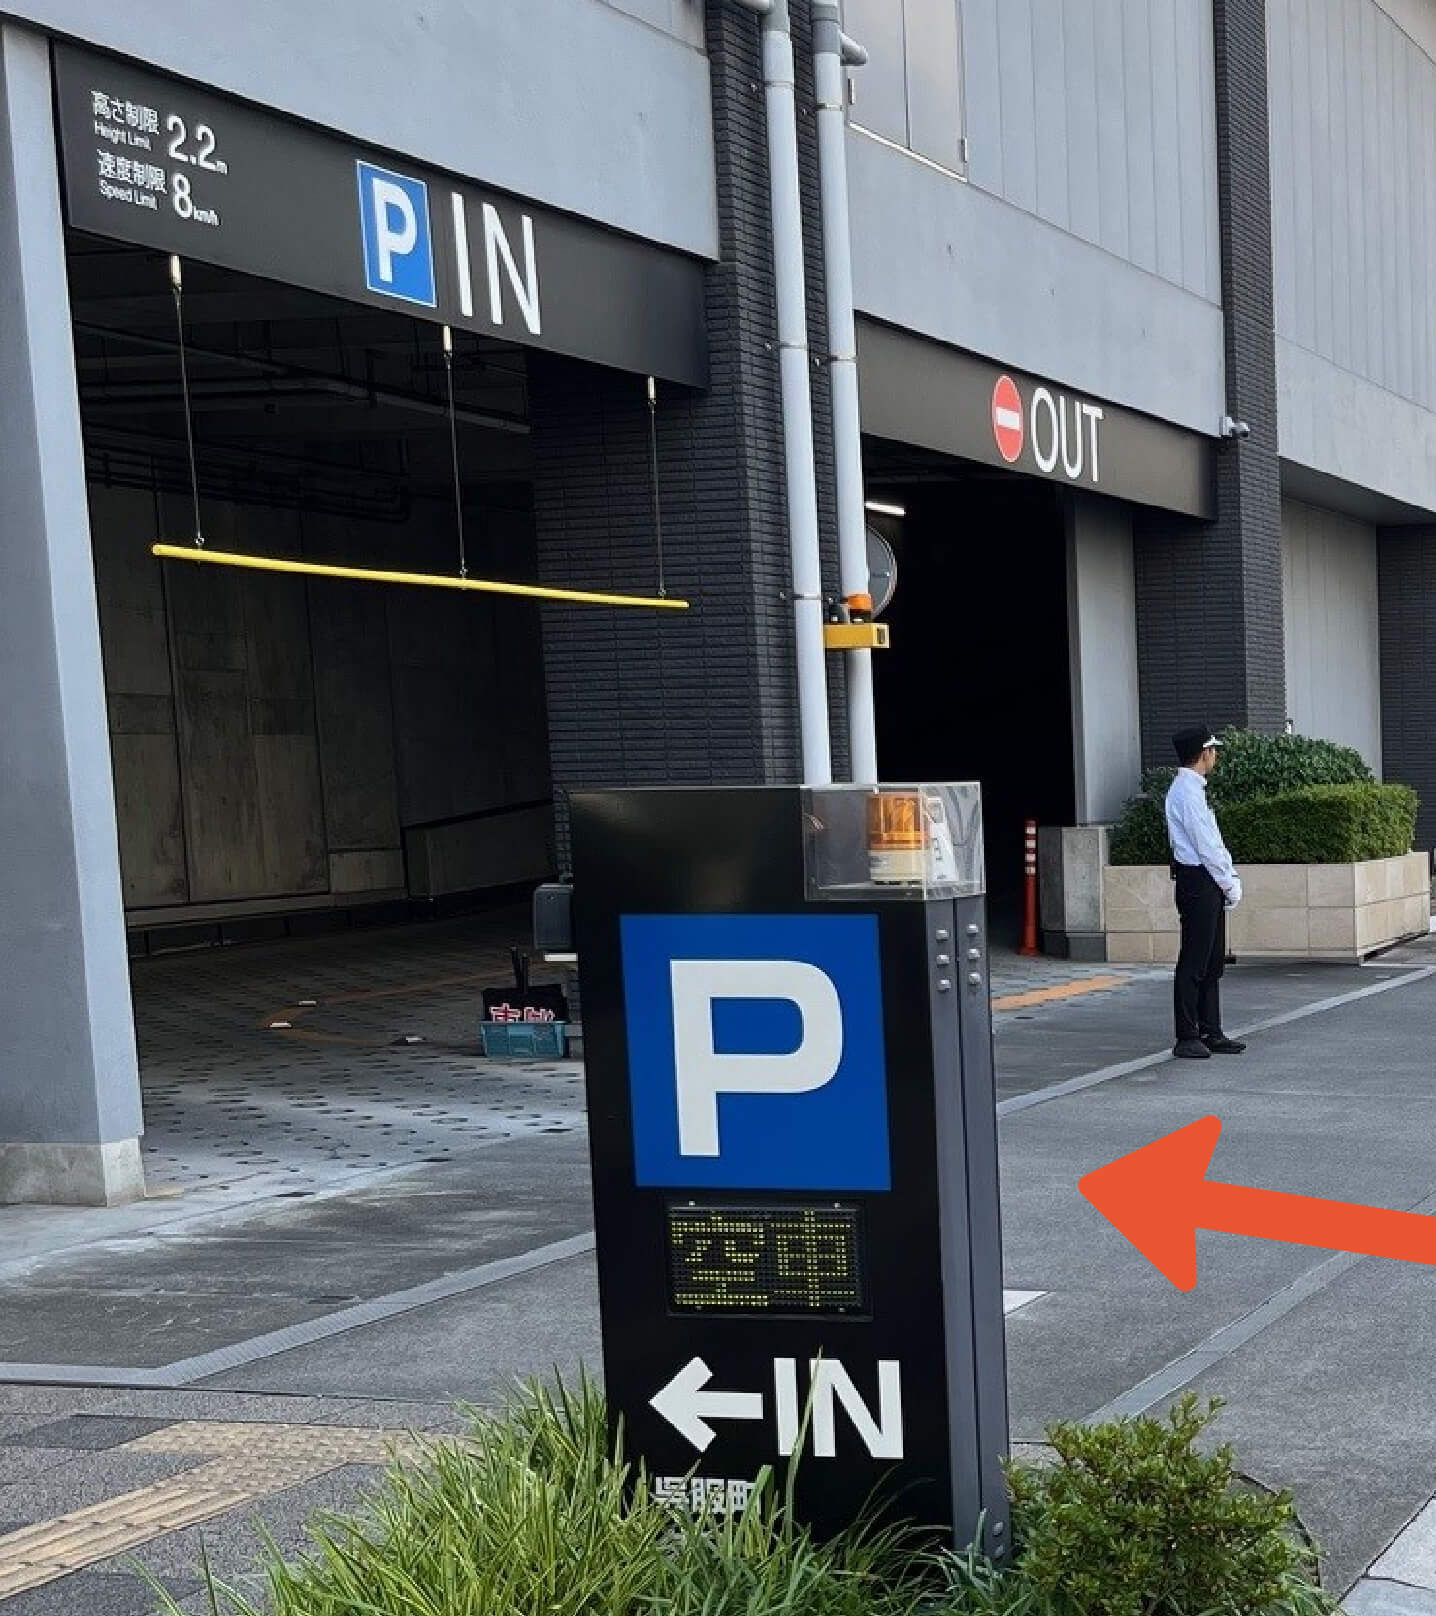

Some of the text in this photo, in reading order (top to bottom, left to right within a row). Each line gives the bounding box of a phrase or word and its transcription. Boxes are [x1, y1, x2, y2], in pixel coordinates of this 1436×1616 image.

[91, 90, 159, 134] 高さ制限
[97, 149, 167, 194] 速度制限
[100, 180, 133, 203] Speed
[373, 177, 541, 335] P IN
[1030, 387, 1104, 483] OUT
[670, 959, 844, 1158] P
[671, 1208, 855, 1307] 空車
[774, 1357, 904, 1459] IN
